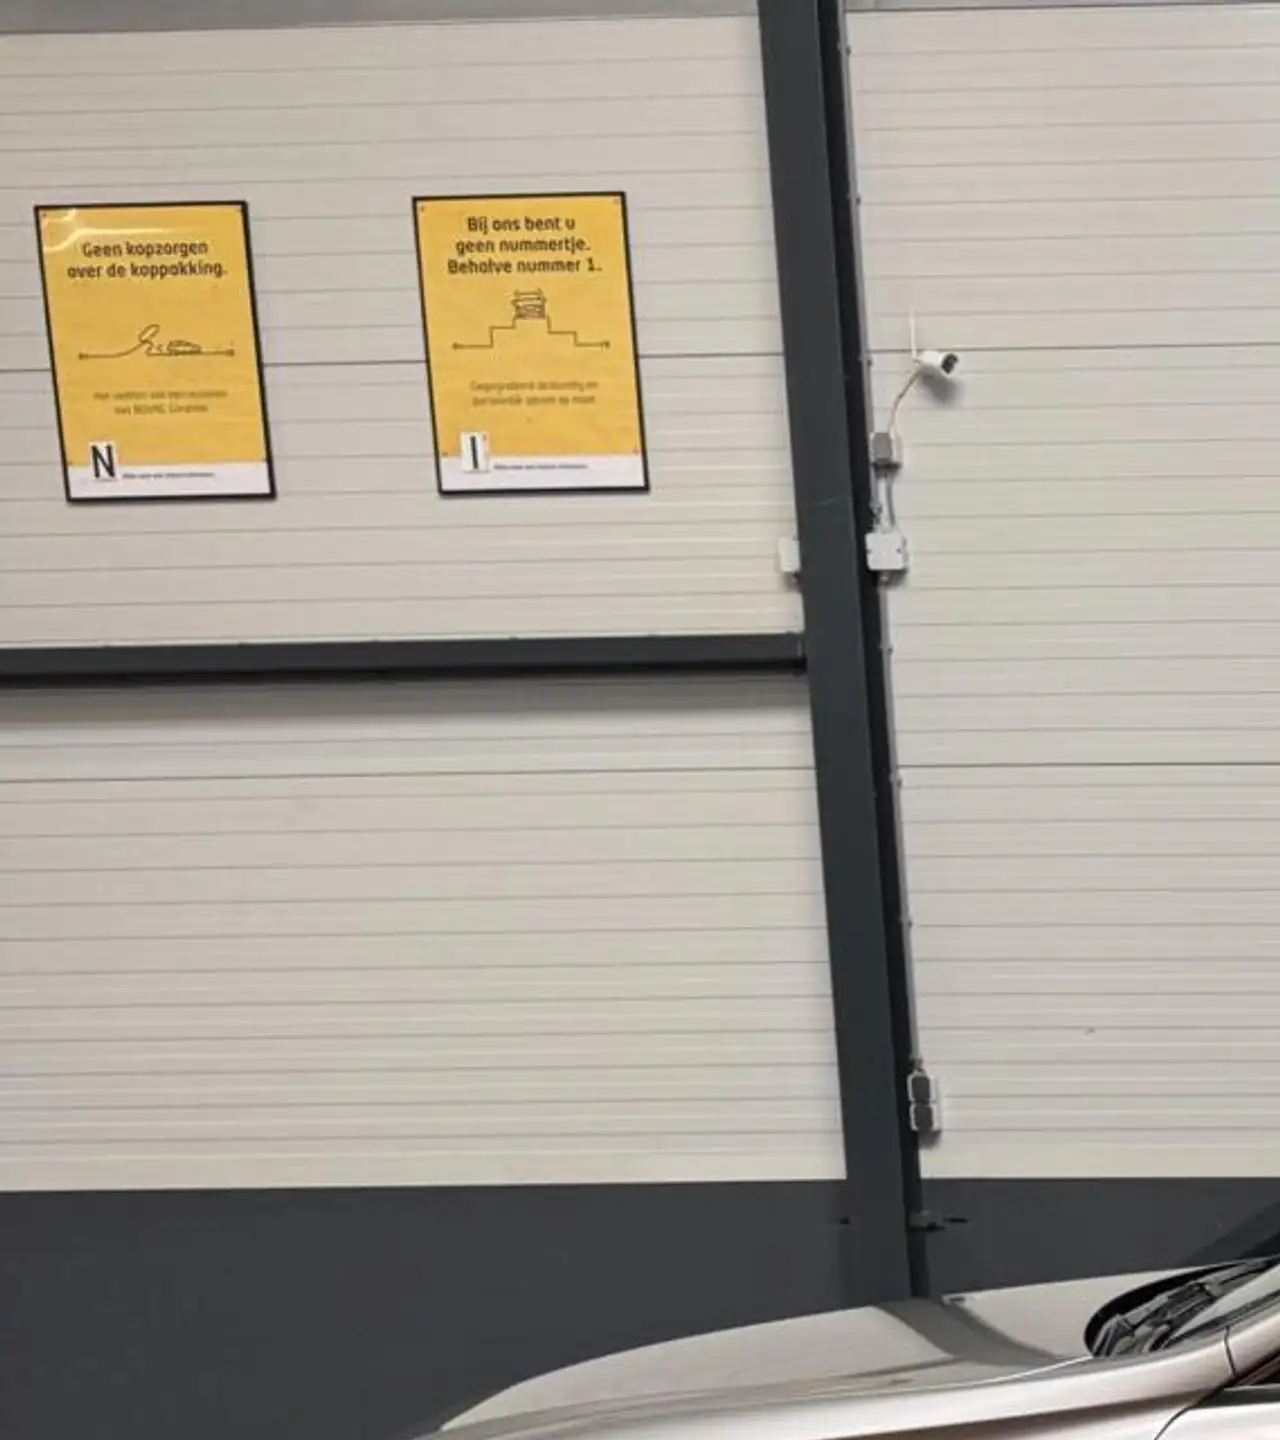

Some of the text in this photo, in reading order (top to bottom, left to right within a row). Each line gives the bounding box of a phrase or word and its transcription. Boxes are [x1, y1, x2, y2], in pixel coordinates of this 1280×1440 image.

[466, 215, 576, 234] Bij ons bent u
[82, 239, 209, 259] Geen kopzorgen
[455, 235, 592, 256] geen nummertje.
[67, 259, 228, 280] over de koppakking.
[447, 256, 603, 275] Behalve nummer 1.
[91, 444, 116, 478] N
